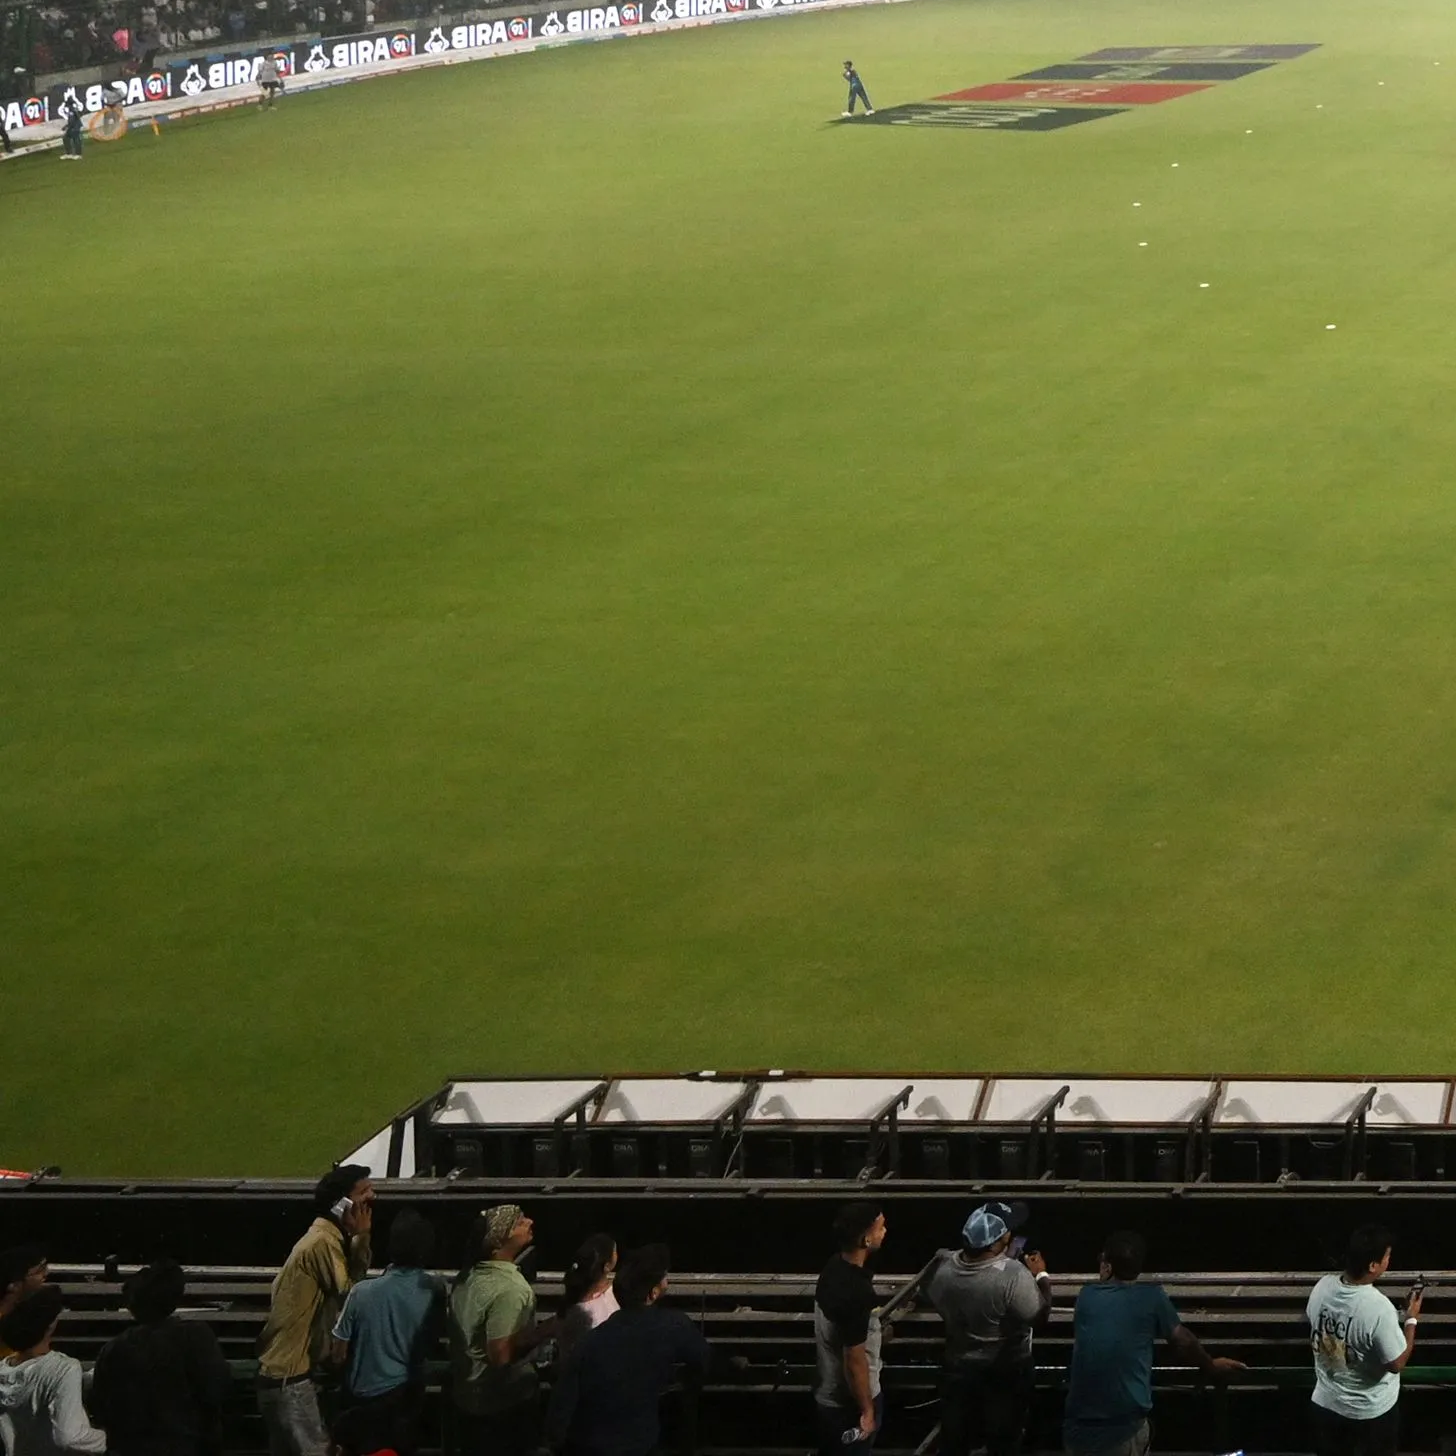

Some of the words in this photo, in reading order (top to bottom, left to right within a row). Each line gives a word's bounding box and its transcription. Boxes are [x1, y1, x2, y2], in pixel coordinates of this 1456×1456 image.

[452, 21, 507, 46] BIRA
[566, 6, 620, 33] BIRA
[333, 38, 390, 66] BIRA
[85, 79, 144, 110] BRA
[1319, 1308, 1352, 1343] feel
